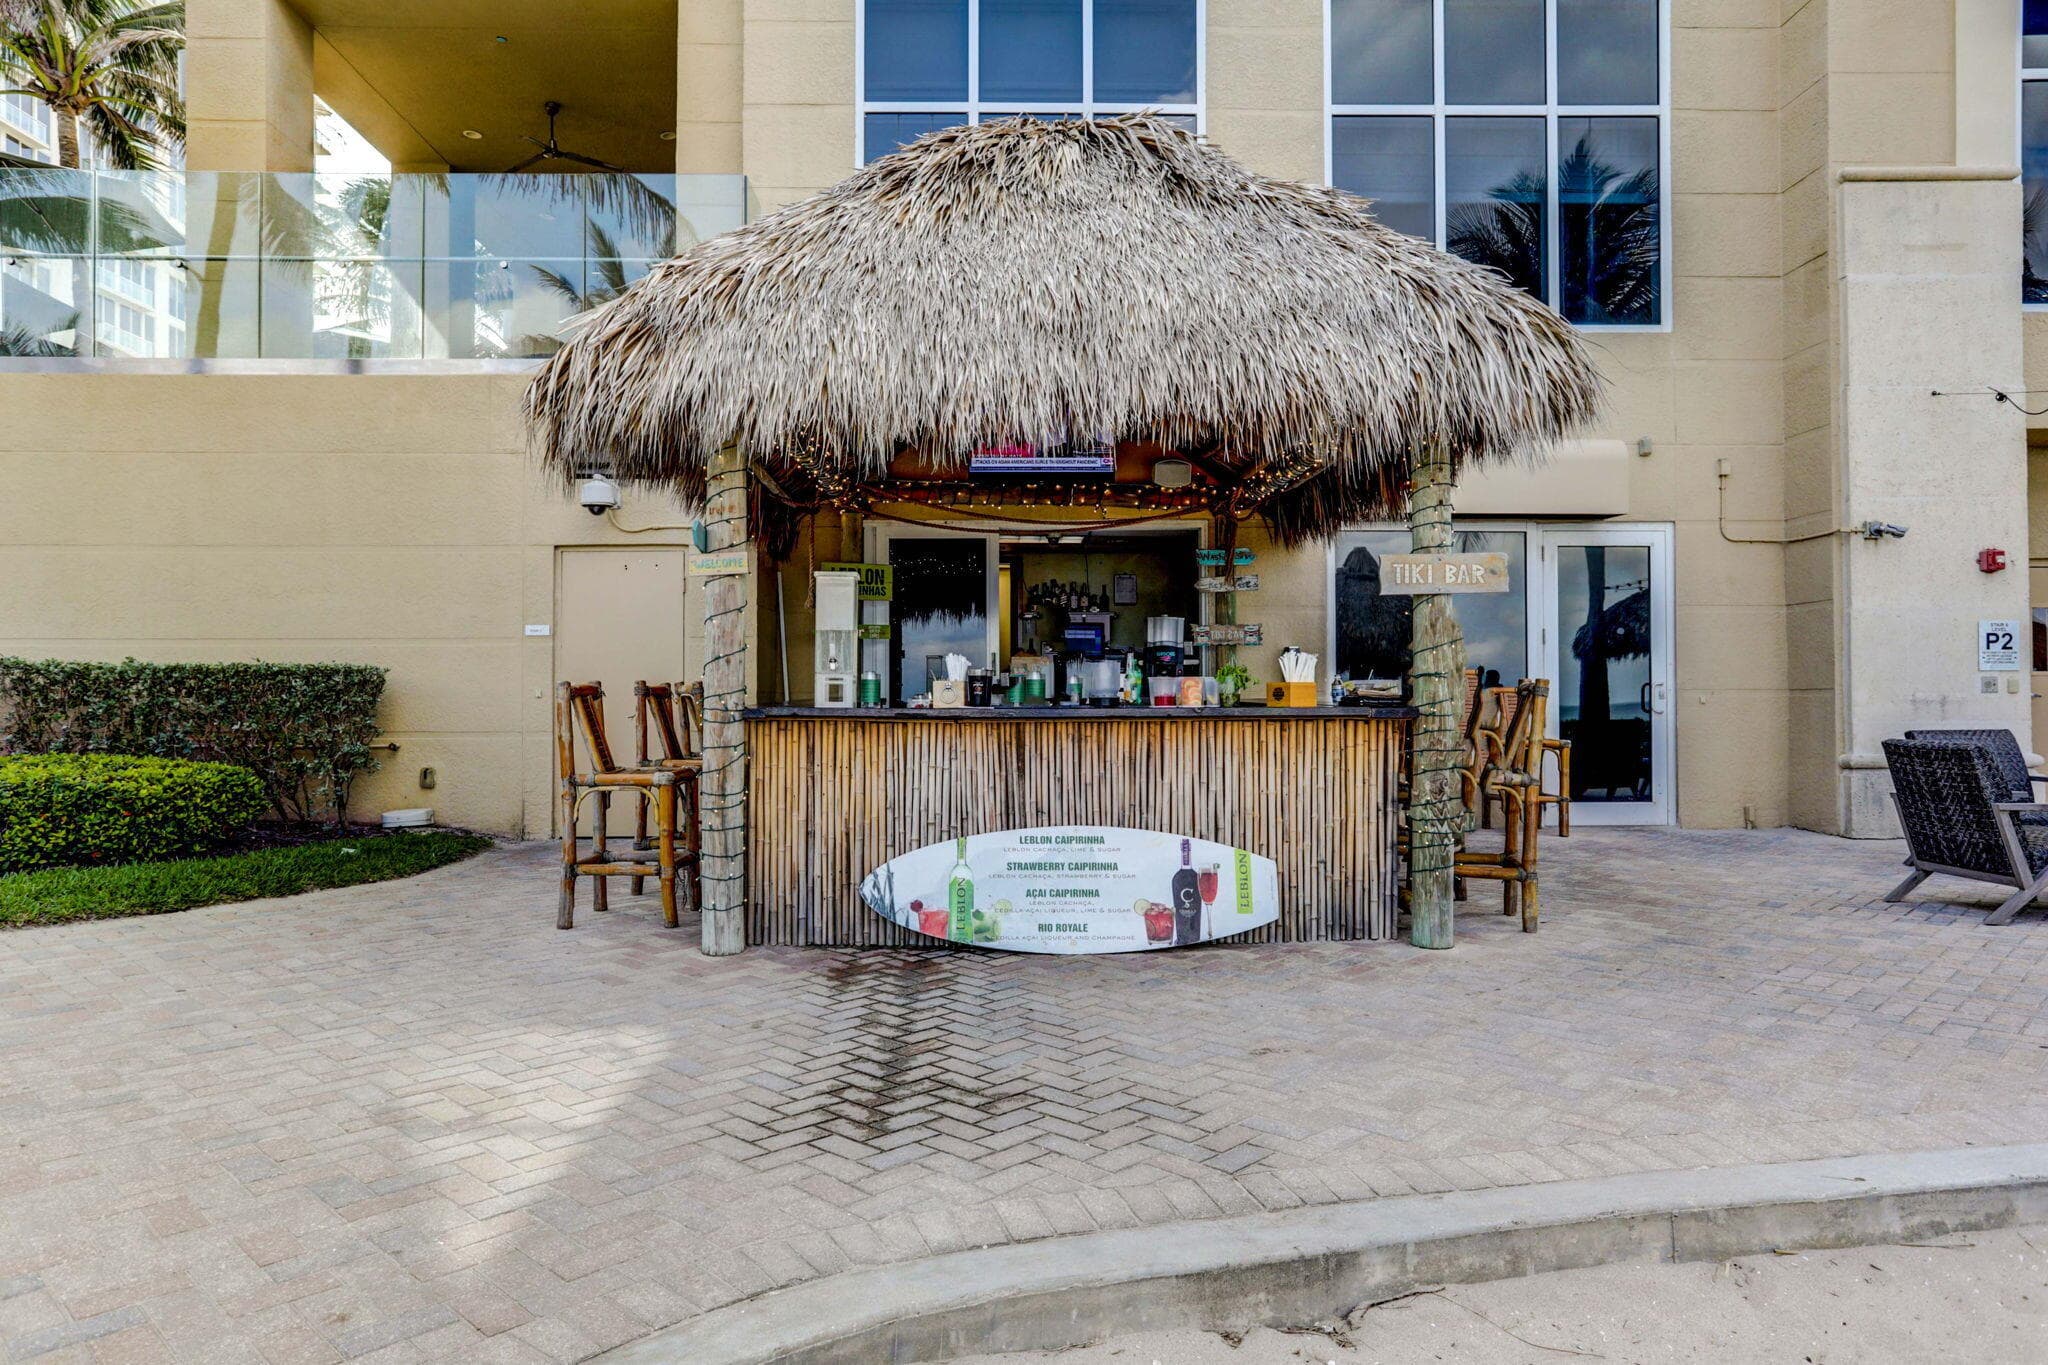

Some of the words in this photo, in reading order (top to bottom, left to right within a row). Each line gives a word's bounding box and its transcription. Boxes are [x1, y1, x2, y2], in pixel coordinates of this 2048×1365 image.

[693, 557, 744, 569] WELCOME
[1392, 563, 1433, 584] TIKI
[1445, 563, 1486, 584] BAR
[1986, 632, 2013, 650] P2
[1019, 835, 1052, 845] LEBLON
[1054, 835, 1105, 845] CAIPIRINHA
[1006, 862, 1065, 871] STRAWBERRY
[1068, 862, 1119, 871] CAIPIRINHA
[1239, 853, 1250, 909] LEBLON
[1025, 888, 1047, 900] AÇAI
[1049, 888, 1100, 898] CAIPIRINHA
[956, 877, 966, 930] LEBLON
[1037, 923, 1053, 933] RIO
[1055, 923, 1088, 933] ROYALE
